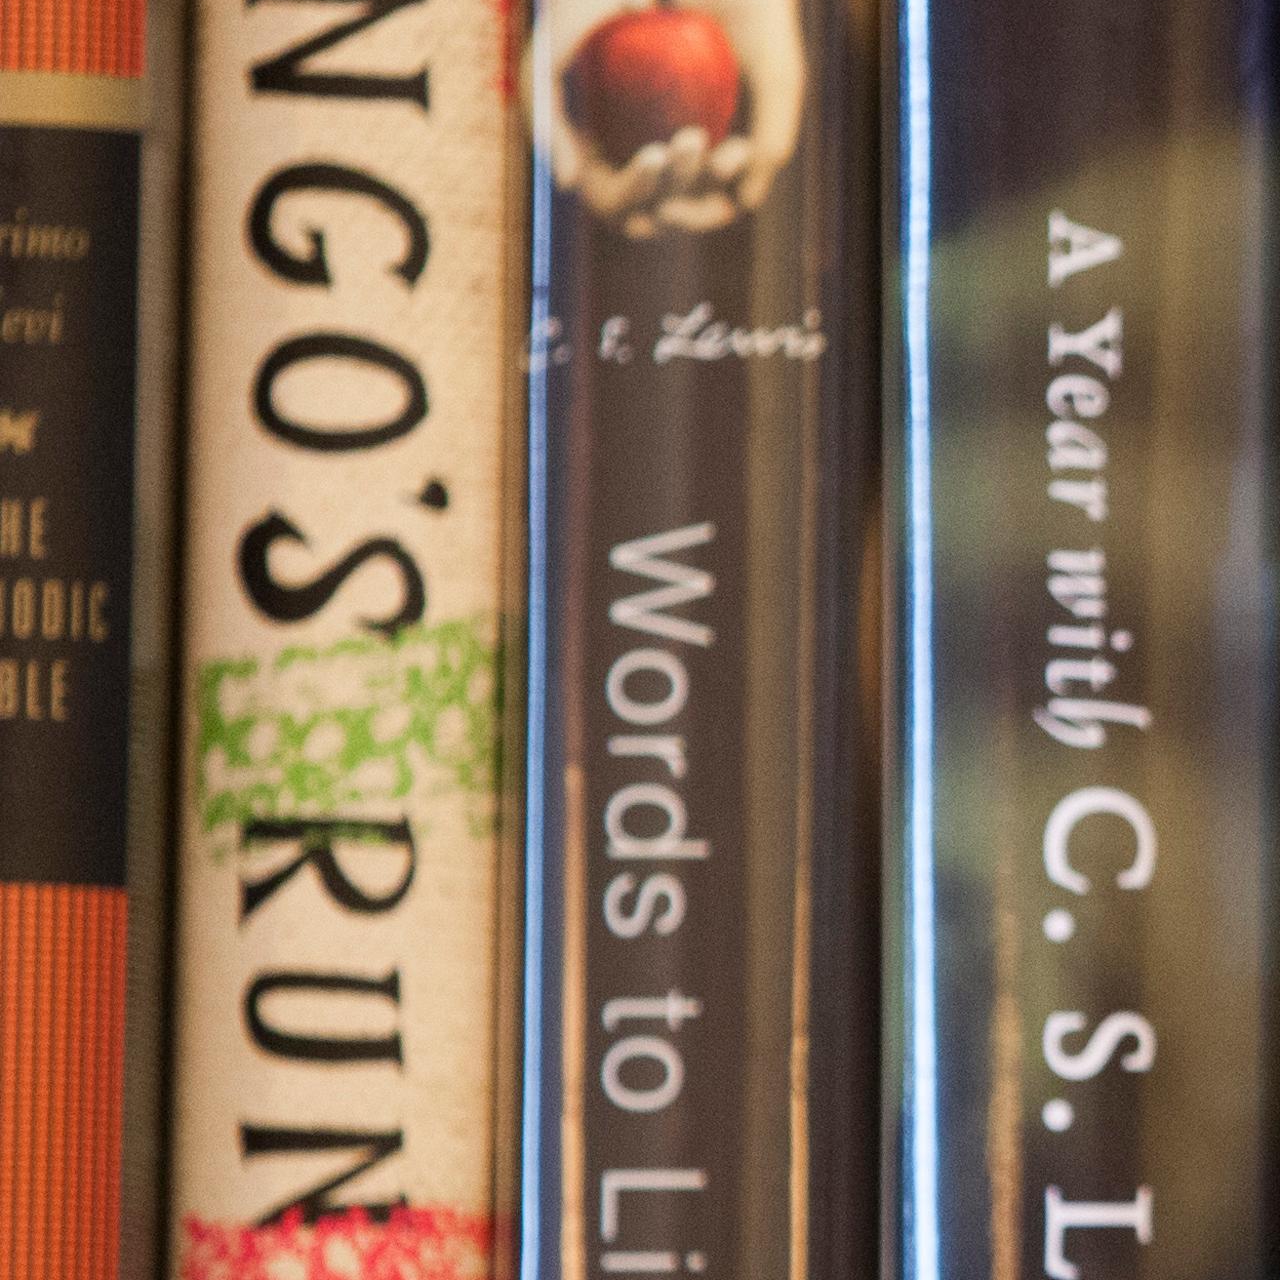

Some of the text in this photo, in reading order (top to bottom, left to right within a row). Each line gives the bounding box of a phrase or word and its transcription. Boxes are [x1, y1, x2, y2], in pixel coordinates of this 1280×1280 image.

[0, 206, 91, 260] rimo
[1047, 209, 1123, 288] A
[0, 287, 64, 344] evi
[1046, 307, 1123, 520] Year
[0, 497, 48, 560] HE
[0, 658, 68, 722] BLE
[1032, 549, 1152, 750] with
[602, 522, 716, 940] Words
[1042, 785, 1159, 943] C.
[239, 816, 417, 1228] RUN
[601, 989, 703, 1114] to
[1042, 1010, 1158, 1132] S.
